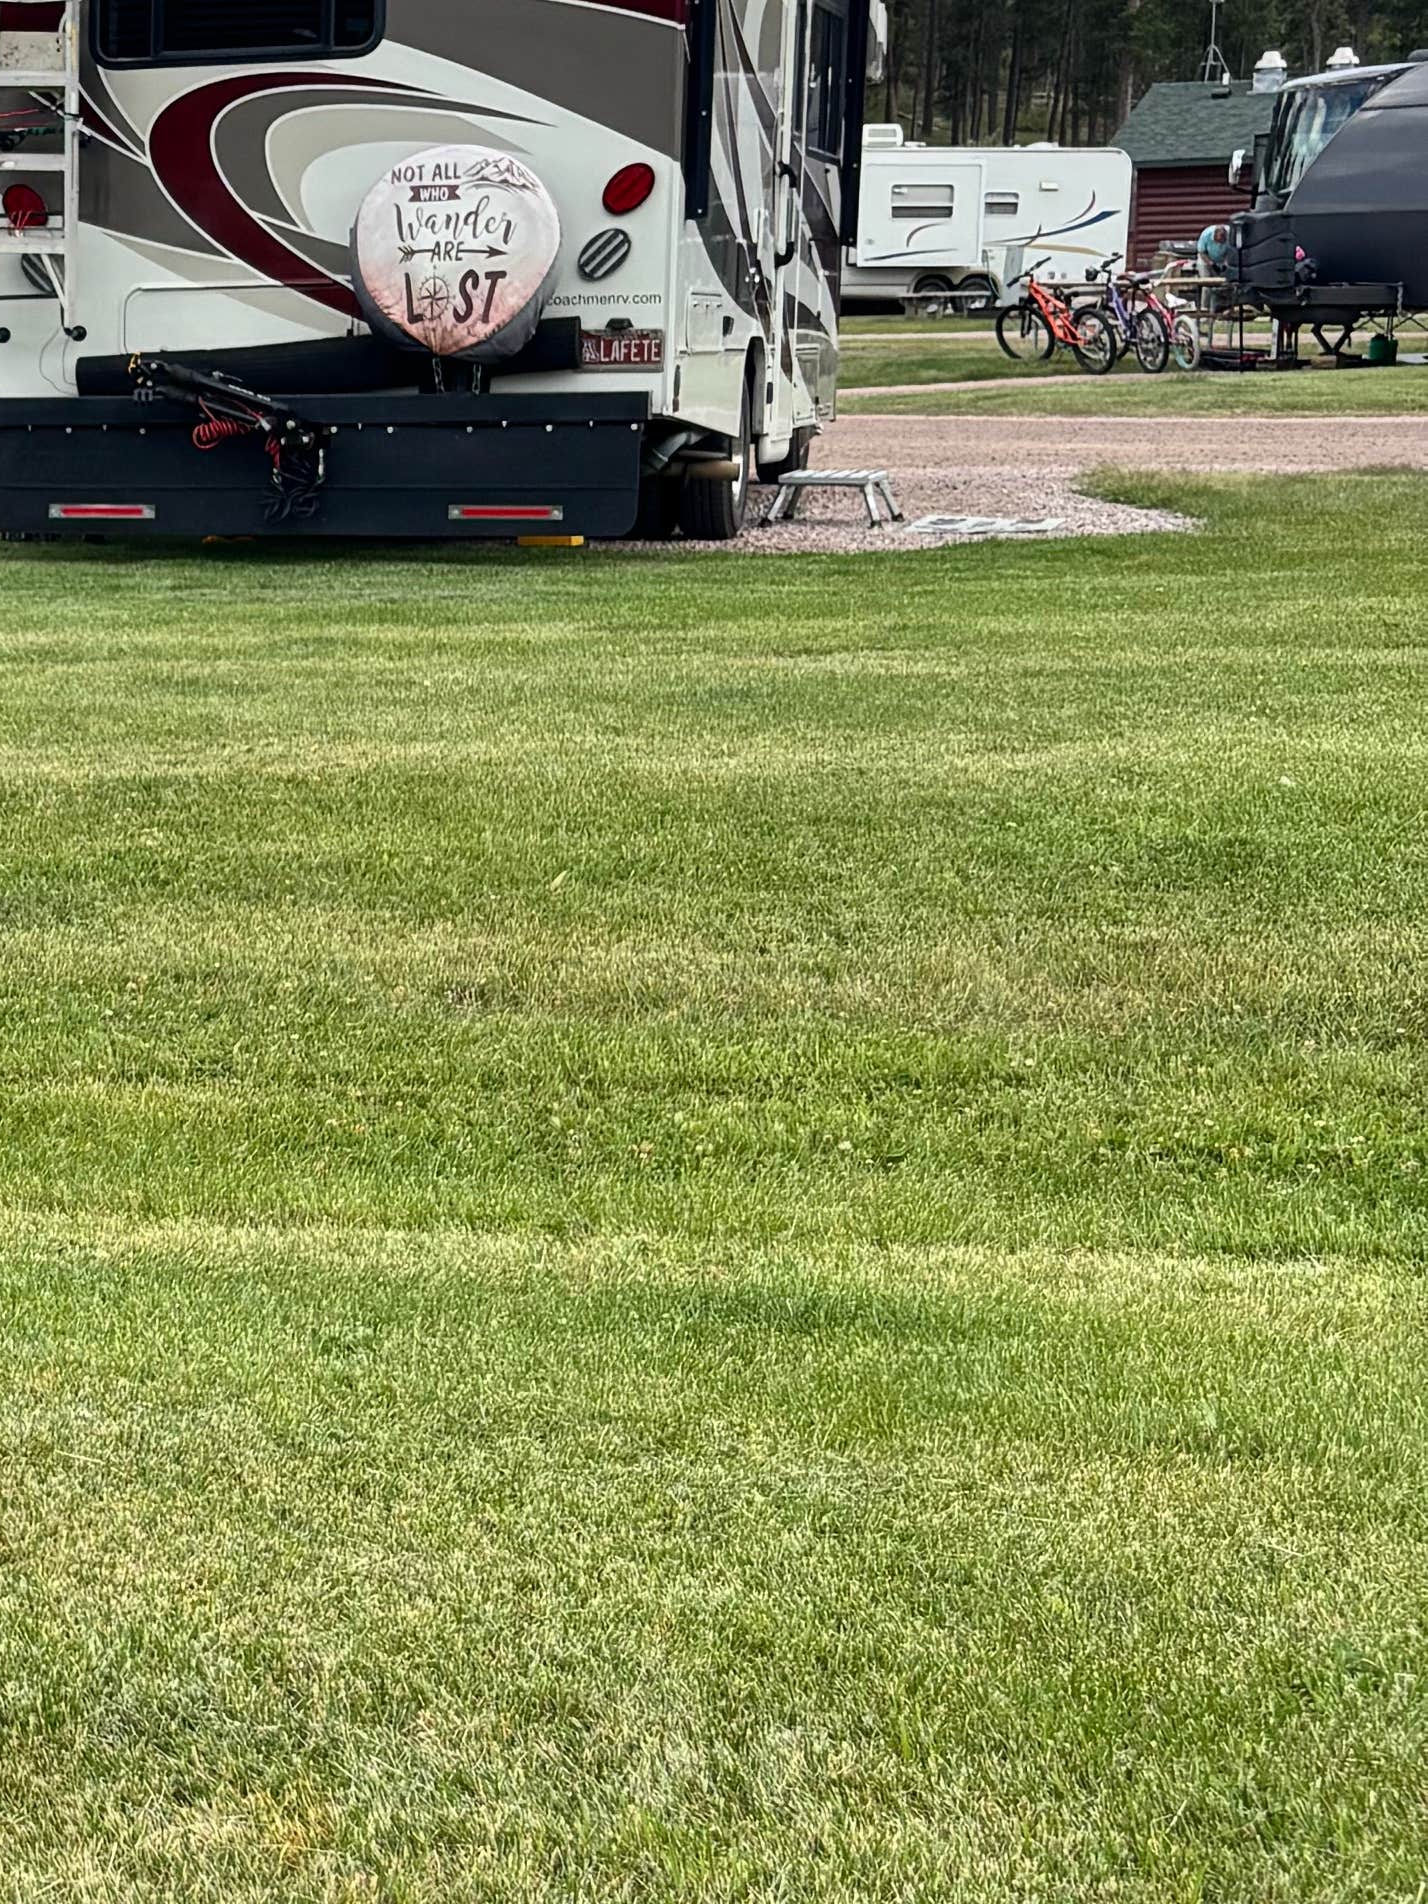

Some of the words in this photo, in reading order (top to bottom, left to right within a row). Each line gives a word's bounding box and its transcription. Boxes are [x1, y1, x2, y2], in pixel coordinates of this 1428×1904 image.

[391, 164, 425, 185] NOT
[431, 161, 462, 181] ALL
[419, 187, 449, 201] WHO
[393, 194, 518, 245] Wander
[430, 240, 465, 262] ARE
[600, 339, 661, 362] LAFETE
